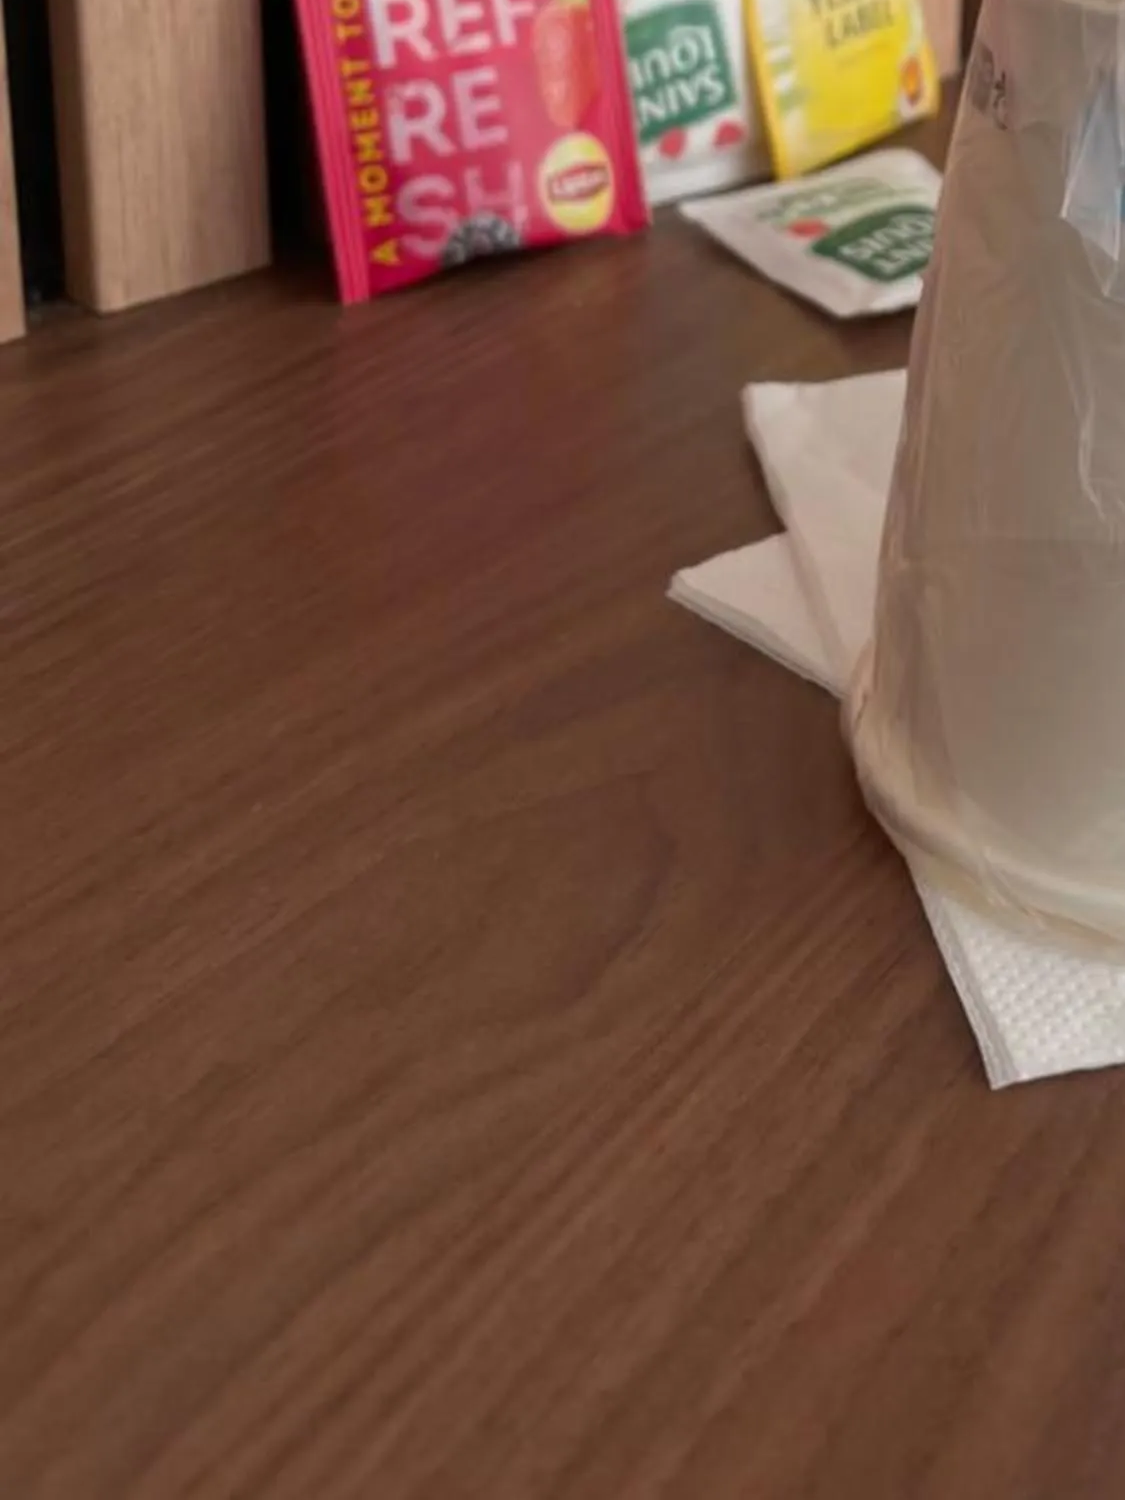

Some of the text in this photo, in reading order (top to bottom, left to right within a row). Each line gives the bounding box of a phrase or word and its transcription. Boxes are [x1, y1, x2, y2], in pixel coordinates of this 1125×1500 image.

[628, 25, 716, 89] LOUI
[636, 64, 726, 127] SAIN
[341, 59, 394, 227] MOMENT
[385, 66, 508, 163] RE
[397, 160, 529, 259] SH
[371, 239, 401, 266] A
